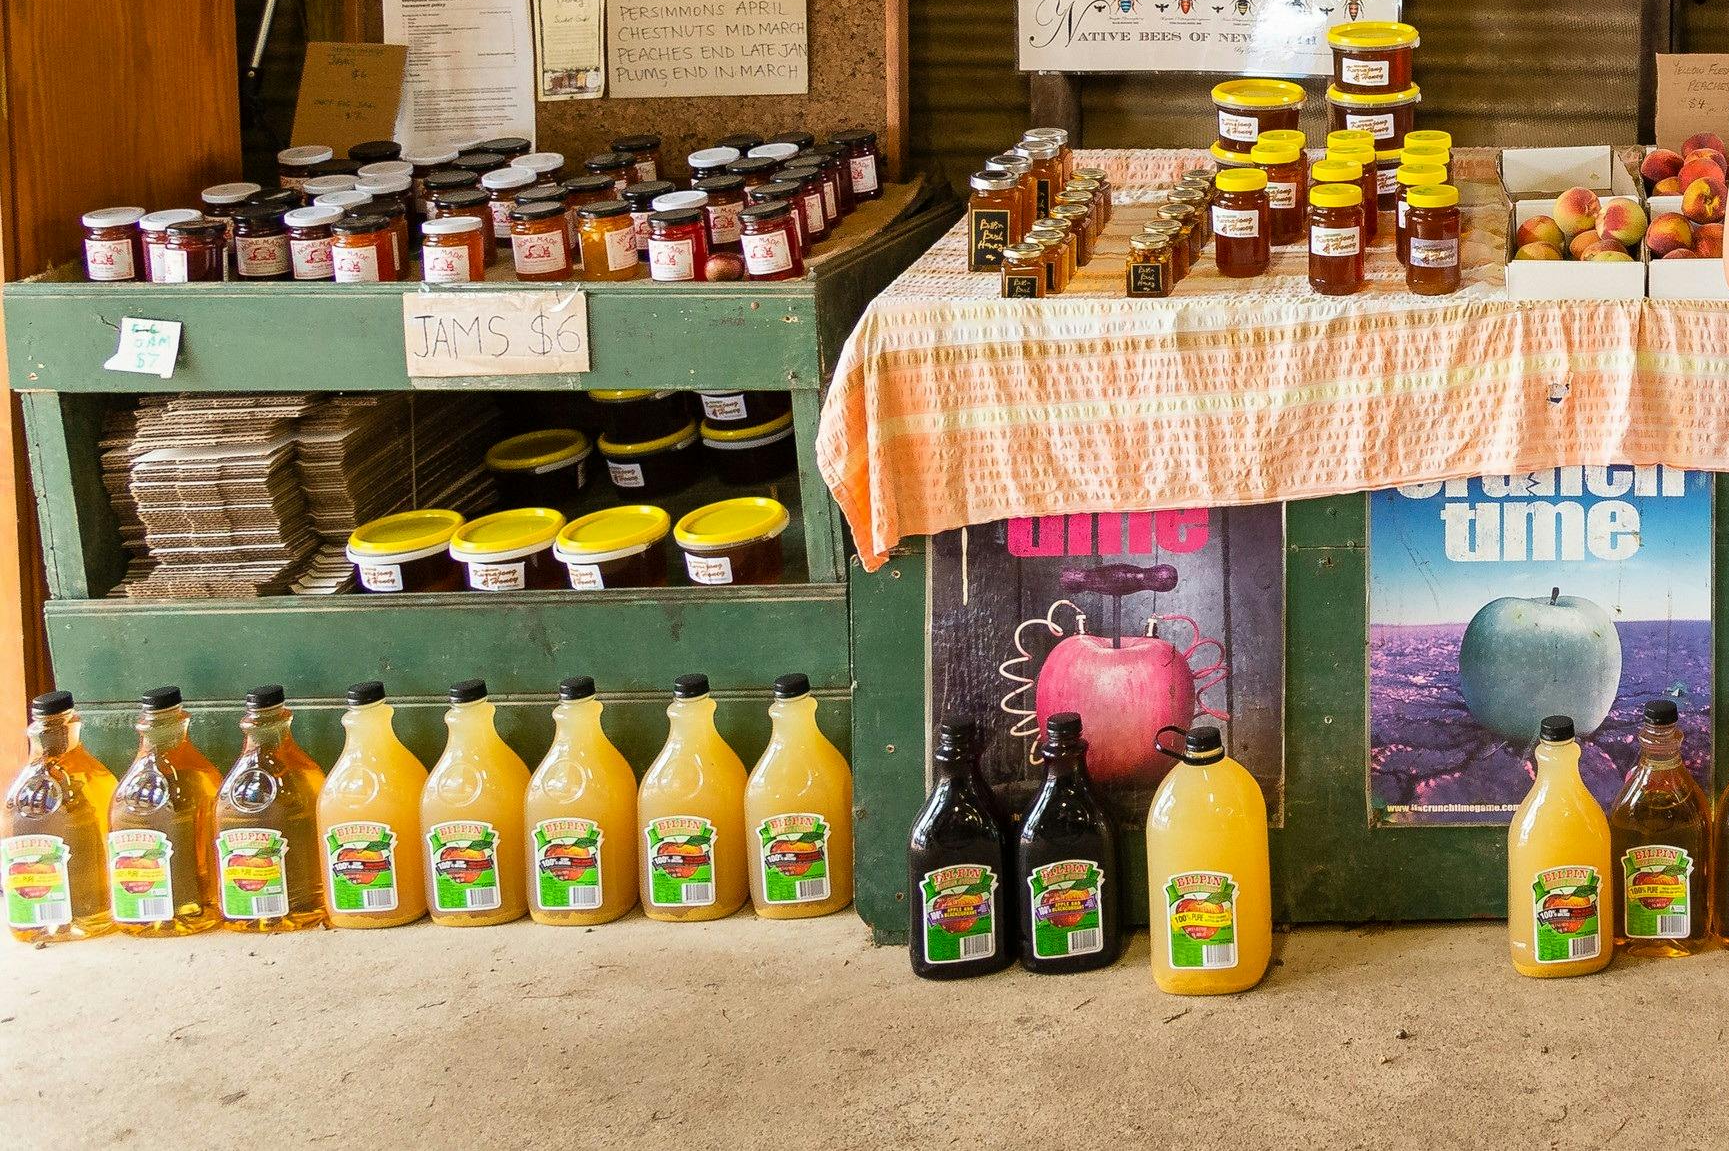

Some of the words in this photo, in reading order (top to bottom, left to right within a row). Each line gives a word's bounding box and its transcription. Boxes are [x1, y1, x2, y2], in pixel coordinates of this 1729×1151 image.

[619, 4, 725, 22] PERSIMMONS
[735, 0, 790, 16] APRIL
[617, 24, 715, 42] CHESTNUTS
[725, 22, 755, 36] MID
[759, 21, 805, 35] MARCH
[1139, 32, 1182, 43] BEES
[1188, 32, 1211, 43] OF
[1218, 32, 1252, 43] NEW
[617, 46, 693, 65] PEACHES
[701, 46, 735, 59] END
[741, 43, 777, 58] LATE
[777, 43, 809, 58] JAN
[615, 66, 668, 82] PLUMS
[673, 66, 707, 79] END
[715, 65, 735, 78] IN
[740, 64, 798, 77] MARCH
[1672, 59, 1705, 76] YELLOW
[1688, 97, 1706, 111] $4
[1331, 242, 1357, 251] Honey
[412, 314, 510, 359] JAMS
[528, 310, 581, 357] $6
[1440, 499, 1641, 562] time
[543, 821, 588, 833] BILPIN
[657, 817, 701, 831] BILPIN
[769, 815, 814, 828] BILPIN
[226, 831, 271, 843] BILPIN
[335, 825, 380, 837] BILPIN
[438, 824, 482, 836] BILPIN
[1633, 848, 1679, 860] BILPIN
[933, 867, 982, 883] BILPIN
[1041, 863, 1088, 879] BILPIN
[1543, 868, 1589, 882] BILPIN
[1176, 874, 1223, 888] BILPIN
[1629, 886, 1646, 895] 100%
[1646, 885, 1659, 894] PURE
[1191, 913, 1204, 922] PURE
